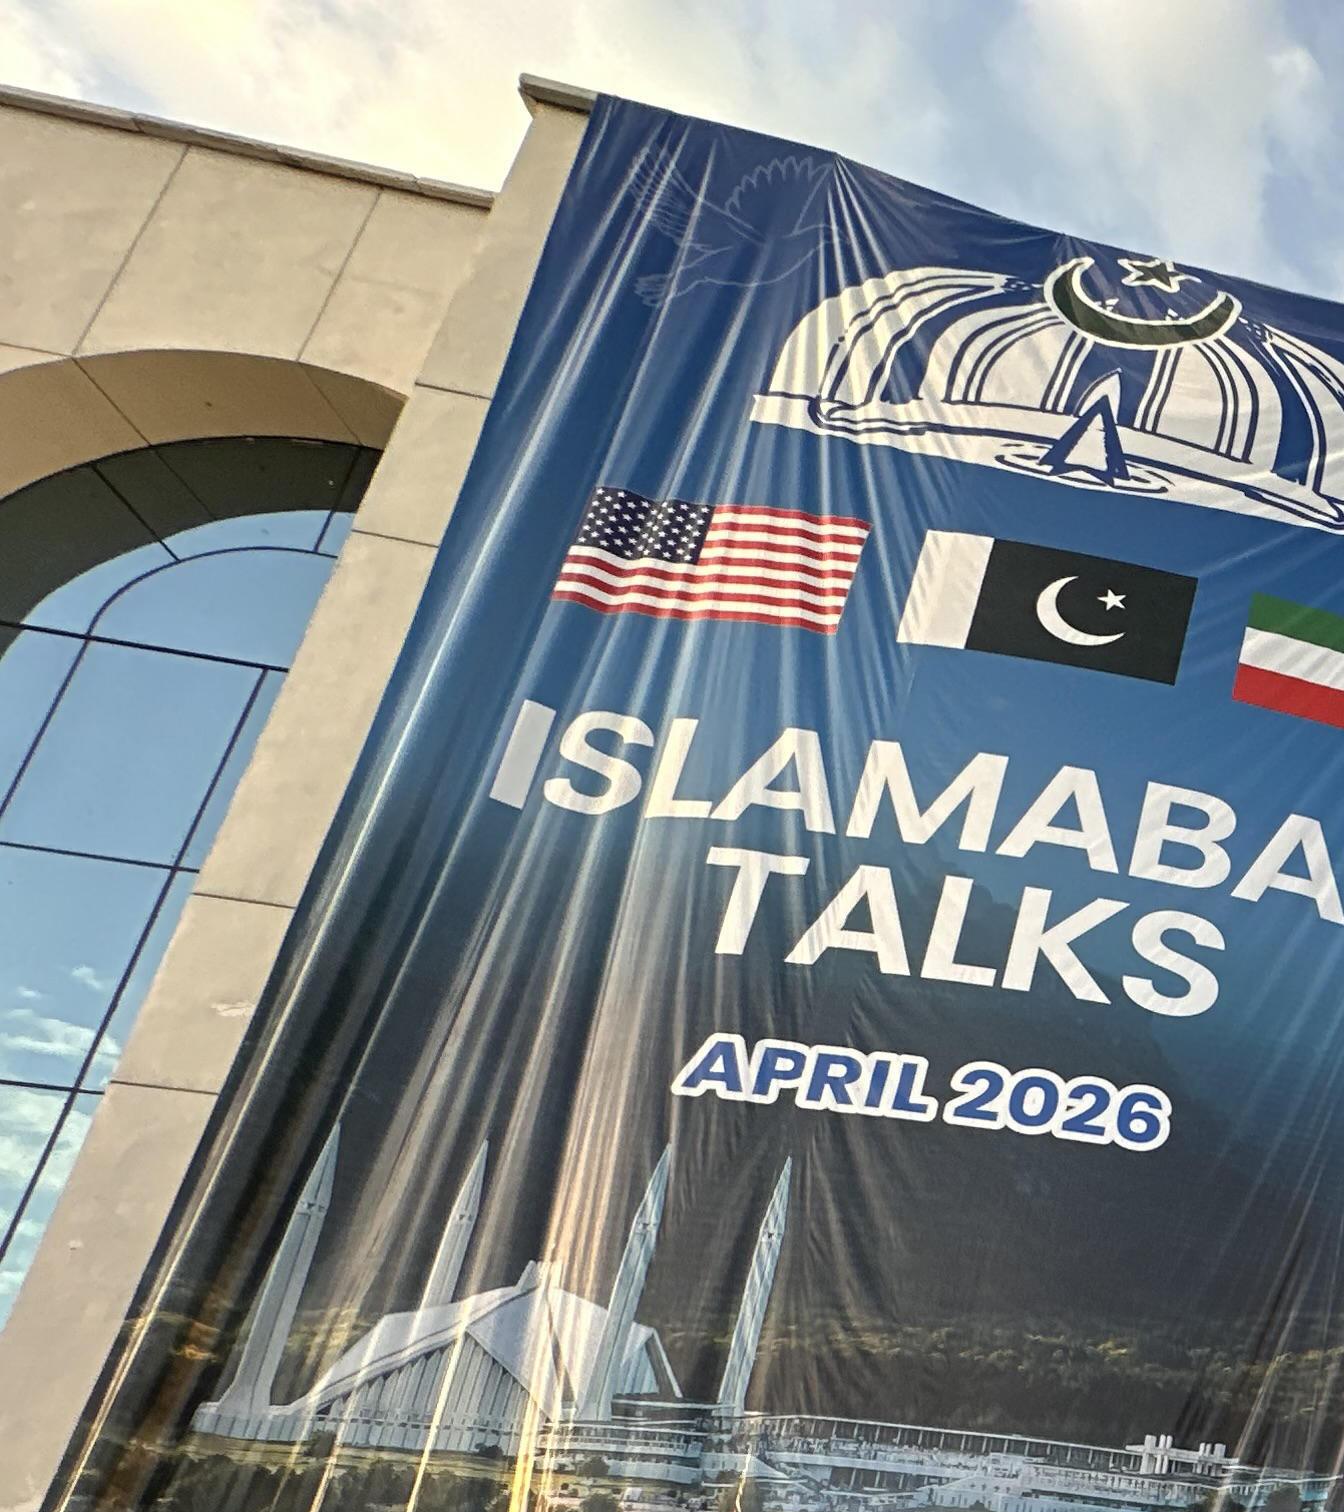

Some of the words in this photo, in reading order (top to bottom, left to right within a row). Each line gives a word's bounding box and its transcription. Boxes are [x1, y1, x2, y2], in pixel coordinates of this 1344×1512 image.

[704, 846, 1227, 1017] TALKS
[673, 1031, 938, 1122] APRIL
[942, 1057, 1173, 1152] 2026
